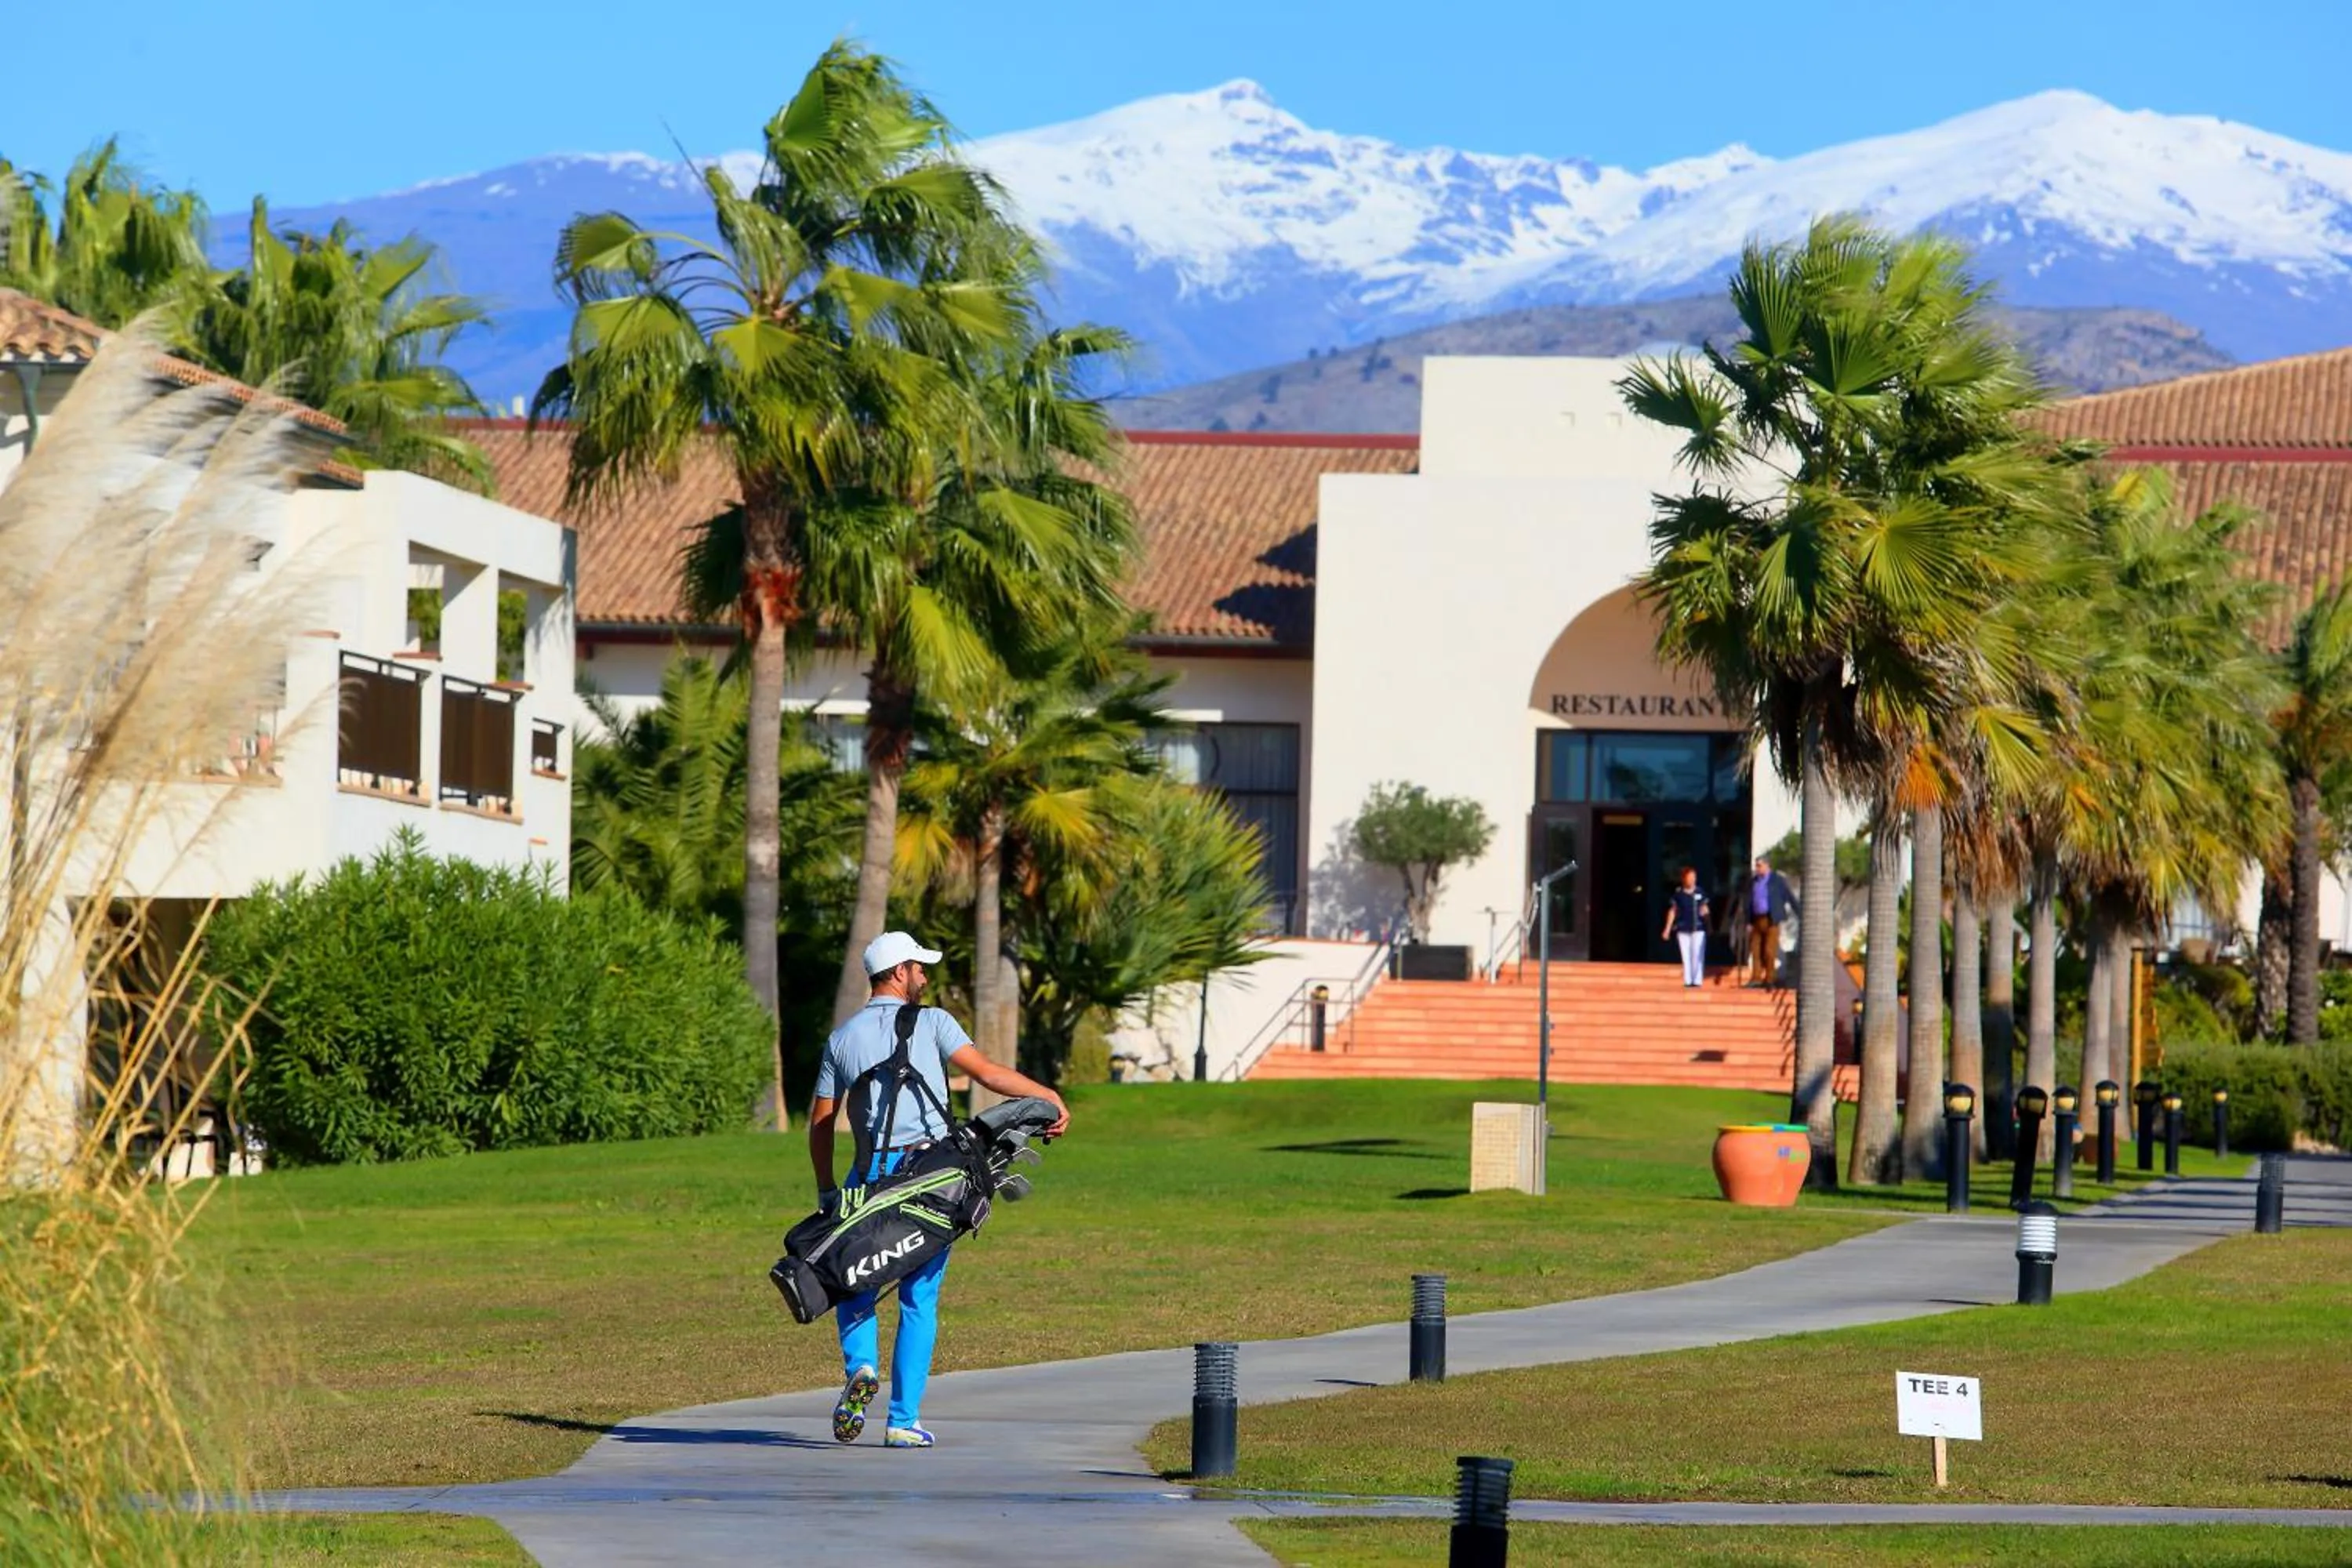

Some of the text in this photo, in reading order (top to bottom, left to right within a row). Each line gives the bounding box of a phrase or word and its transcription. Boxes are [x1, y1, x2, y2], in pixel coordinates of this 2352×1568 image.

[847, 1230, 924, 1287] KING
[1908, 1377, 1969, 1397] TEE 4
